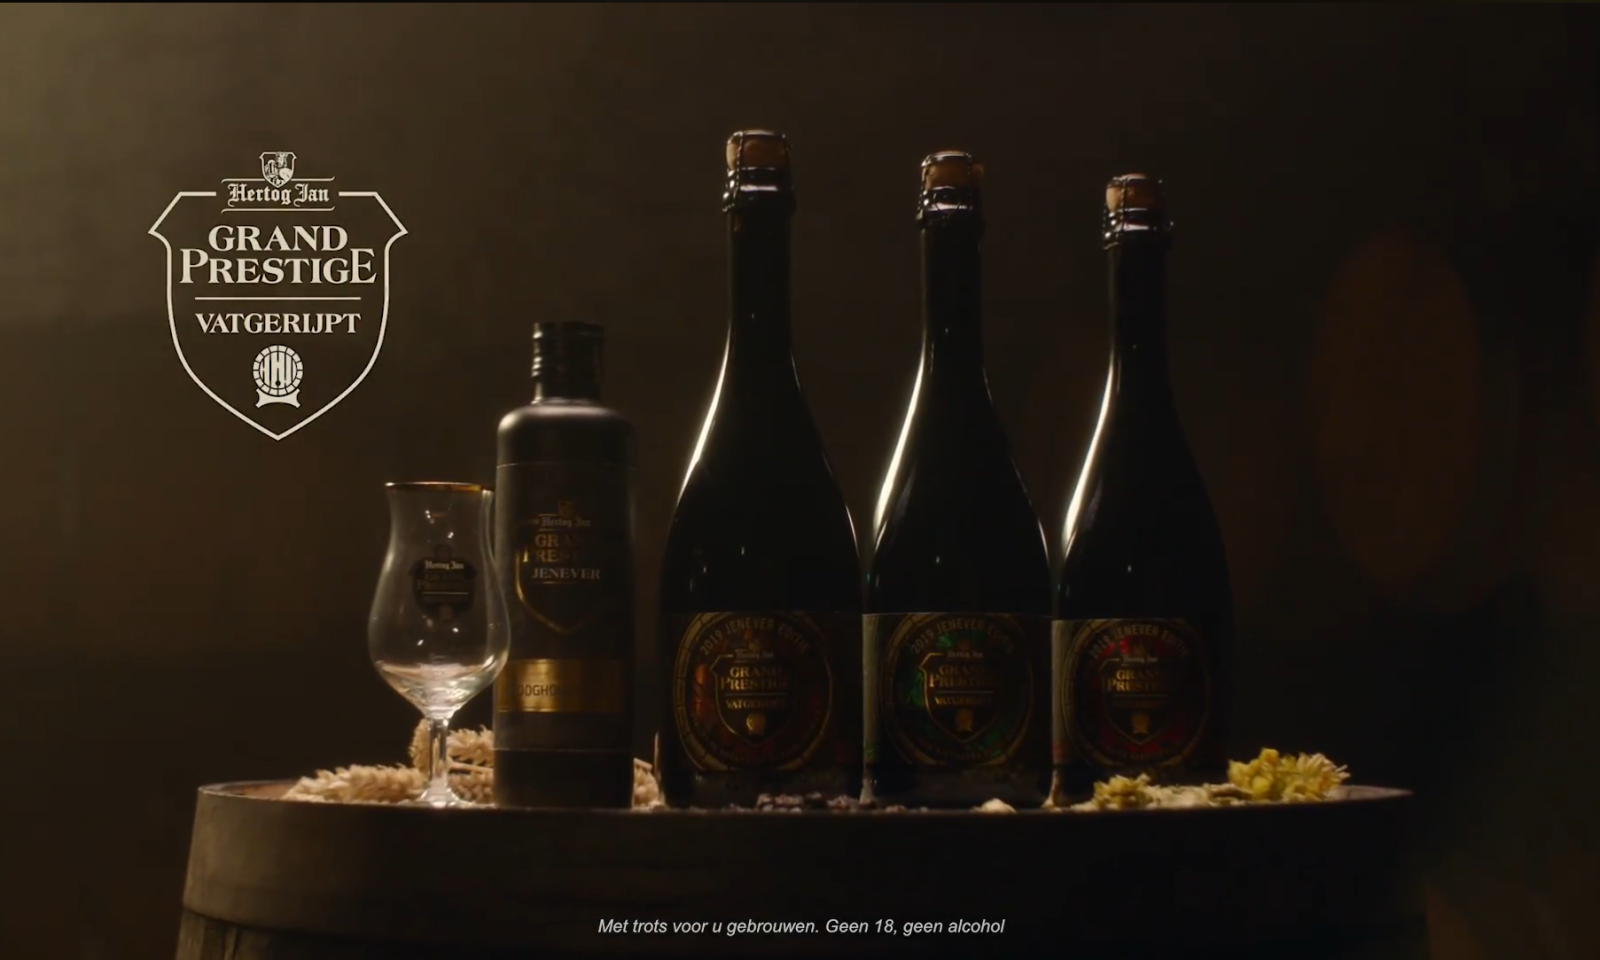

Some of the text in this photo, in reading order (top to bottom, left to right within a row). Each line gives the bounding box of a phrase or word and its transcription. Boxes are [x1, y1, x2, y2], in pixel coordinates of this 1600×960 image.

[532, 567, 601, 580] JENEVER
[700, 629, 724, 656] 2019
[725, 617, 776, 635] JENEVER
[911, 629, 935, 655] 2019
[936, 618, 985, 635] JENEVER
[1114, 624, 1160, 640] JENEVER
